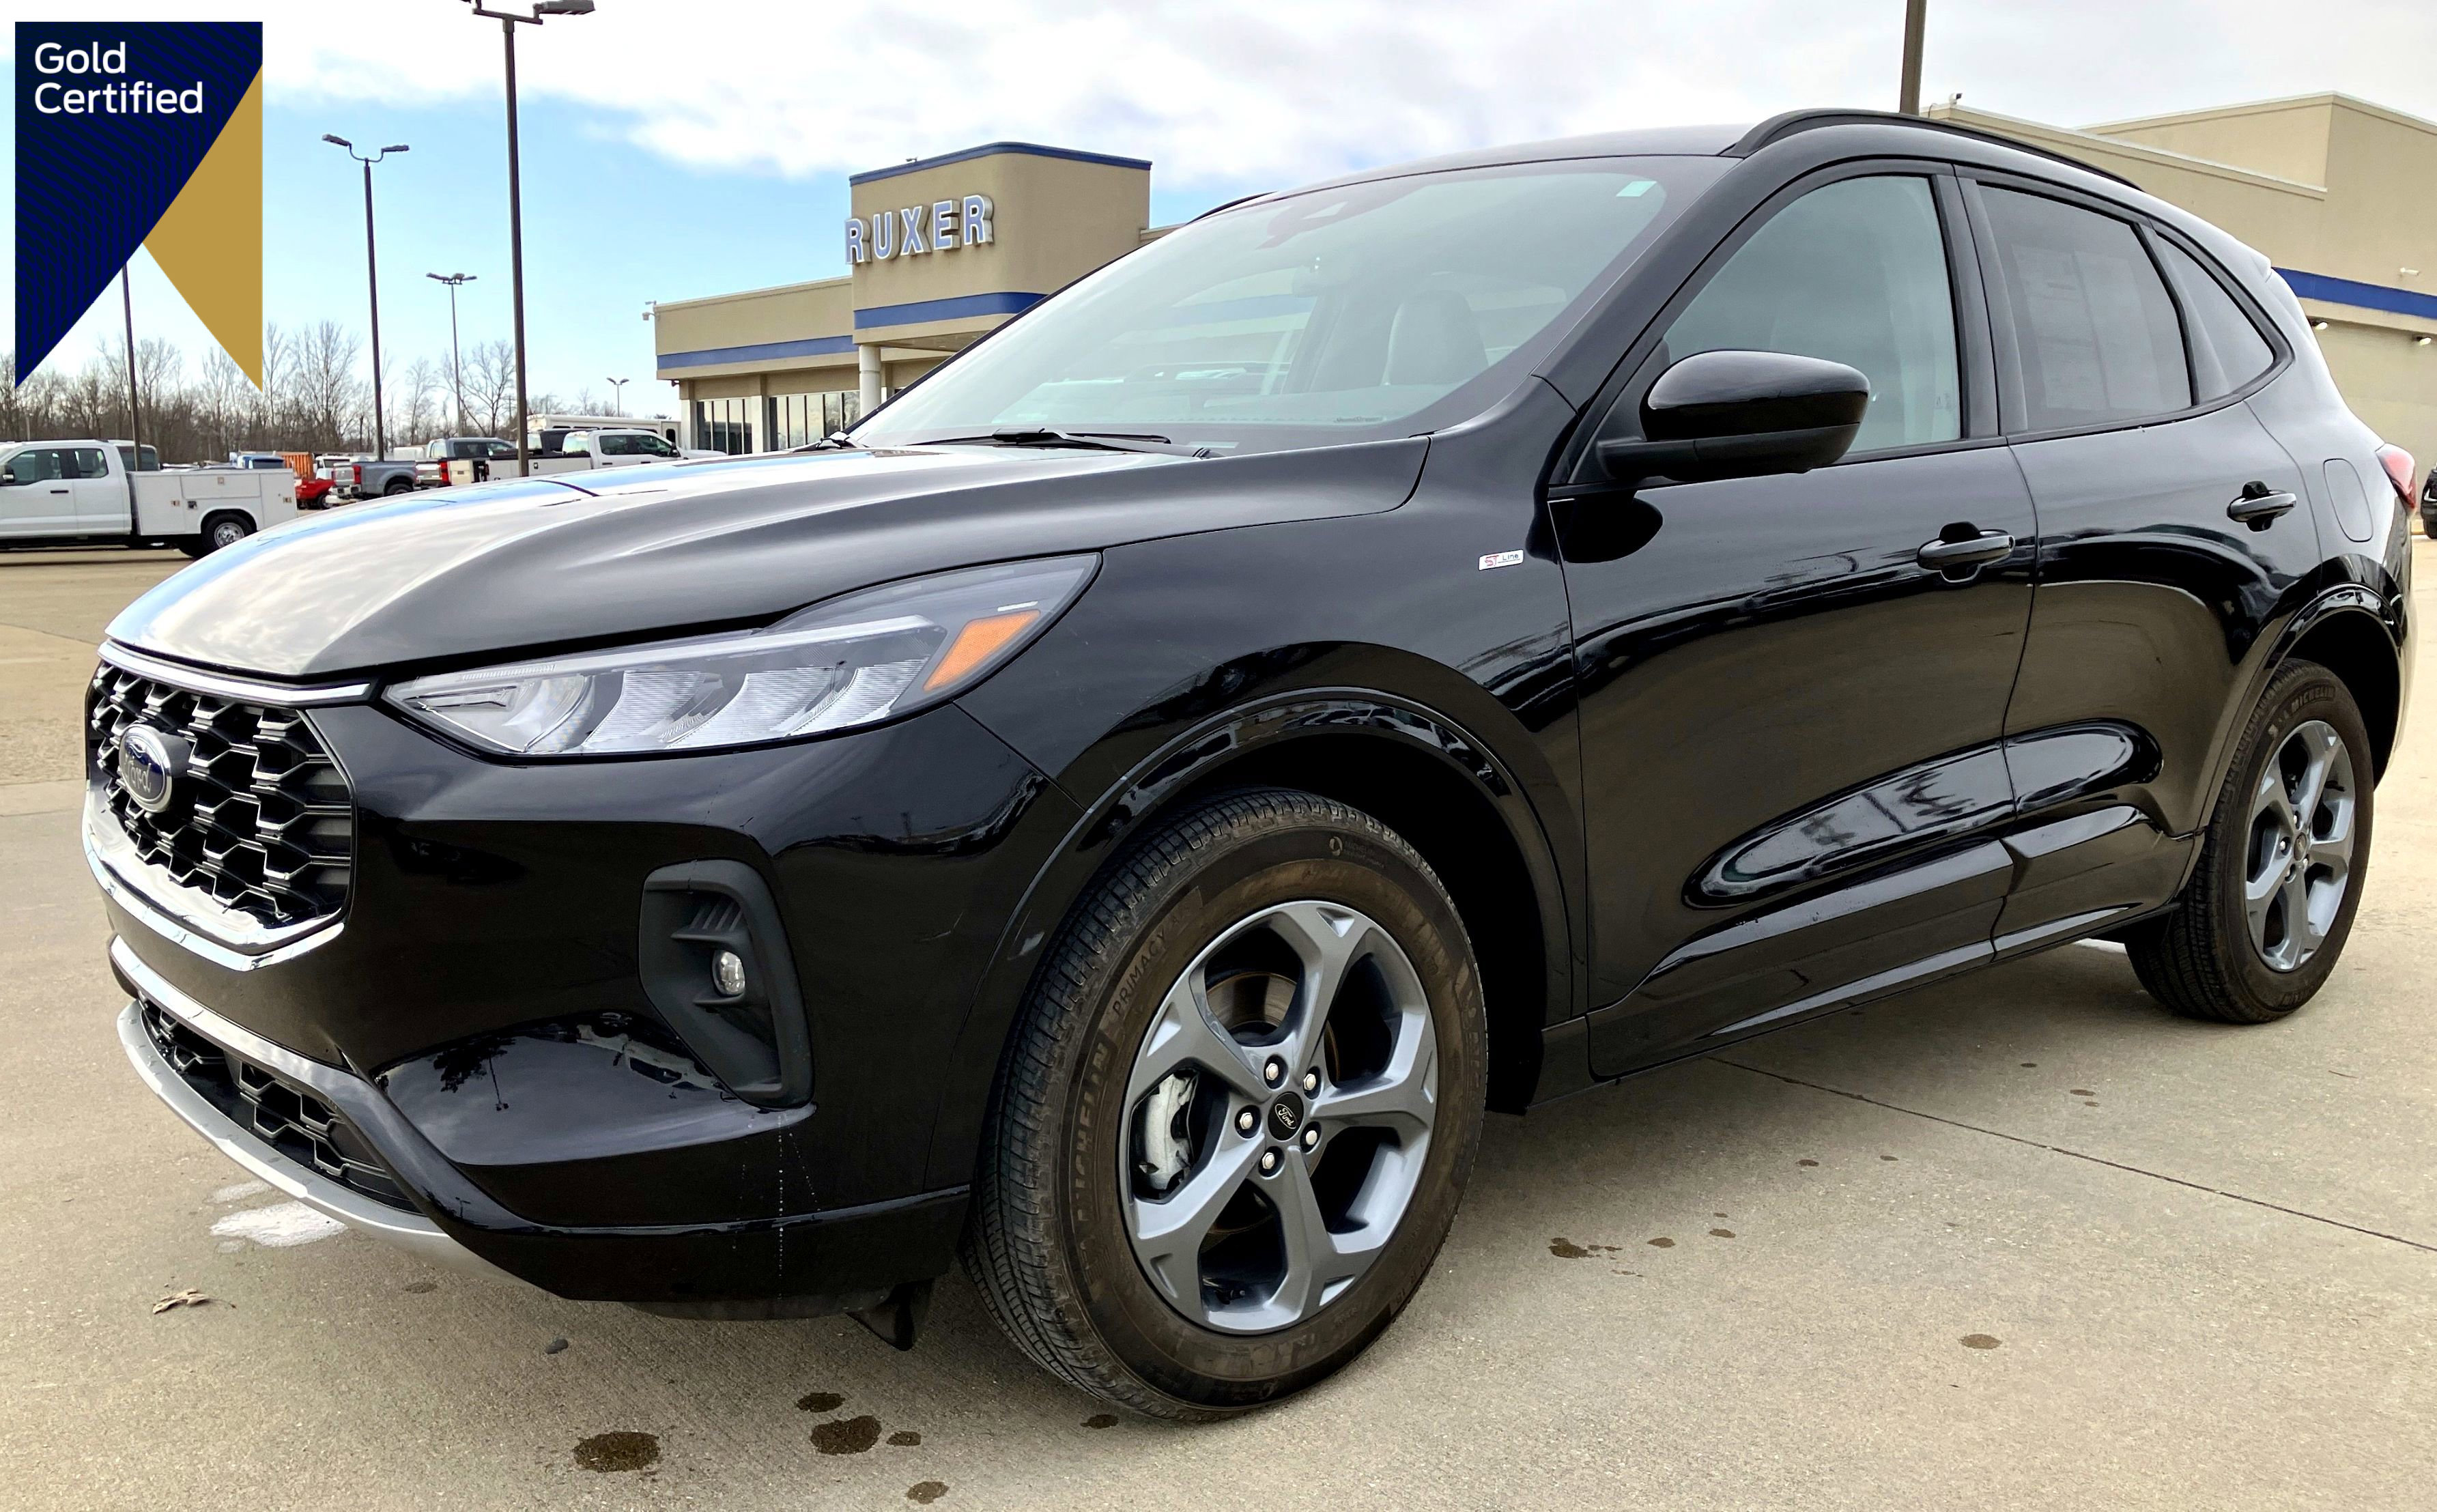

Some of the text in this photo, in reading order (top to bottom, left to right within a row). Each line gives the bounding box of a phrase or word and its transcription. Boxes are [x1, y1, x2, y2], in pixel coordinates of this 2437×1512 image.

[844, 194, 994, 265] RUXER
[124, 743, 152, 793] Ford
[1112, 924, 1167, 1016] PRIMACY
[1278, 1107, 1295, 1126] Ford
